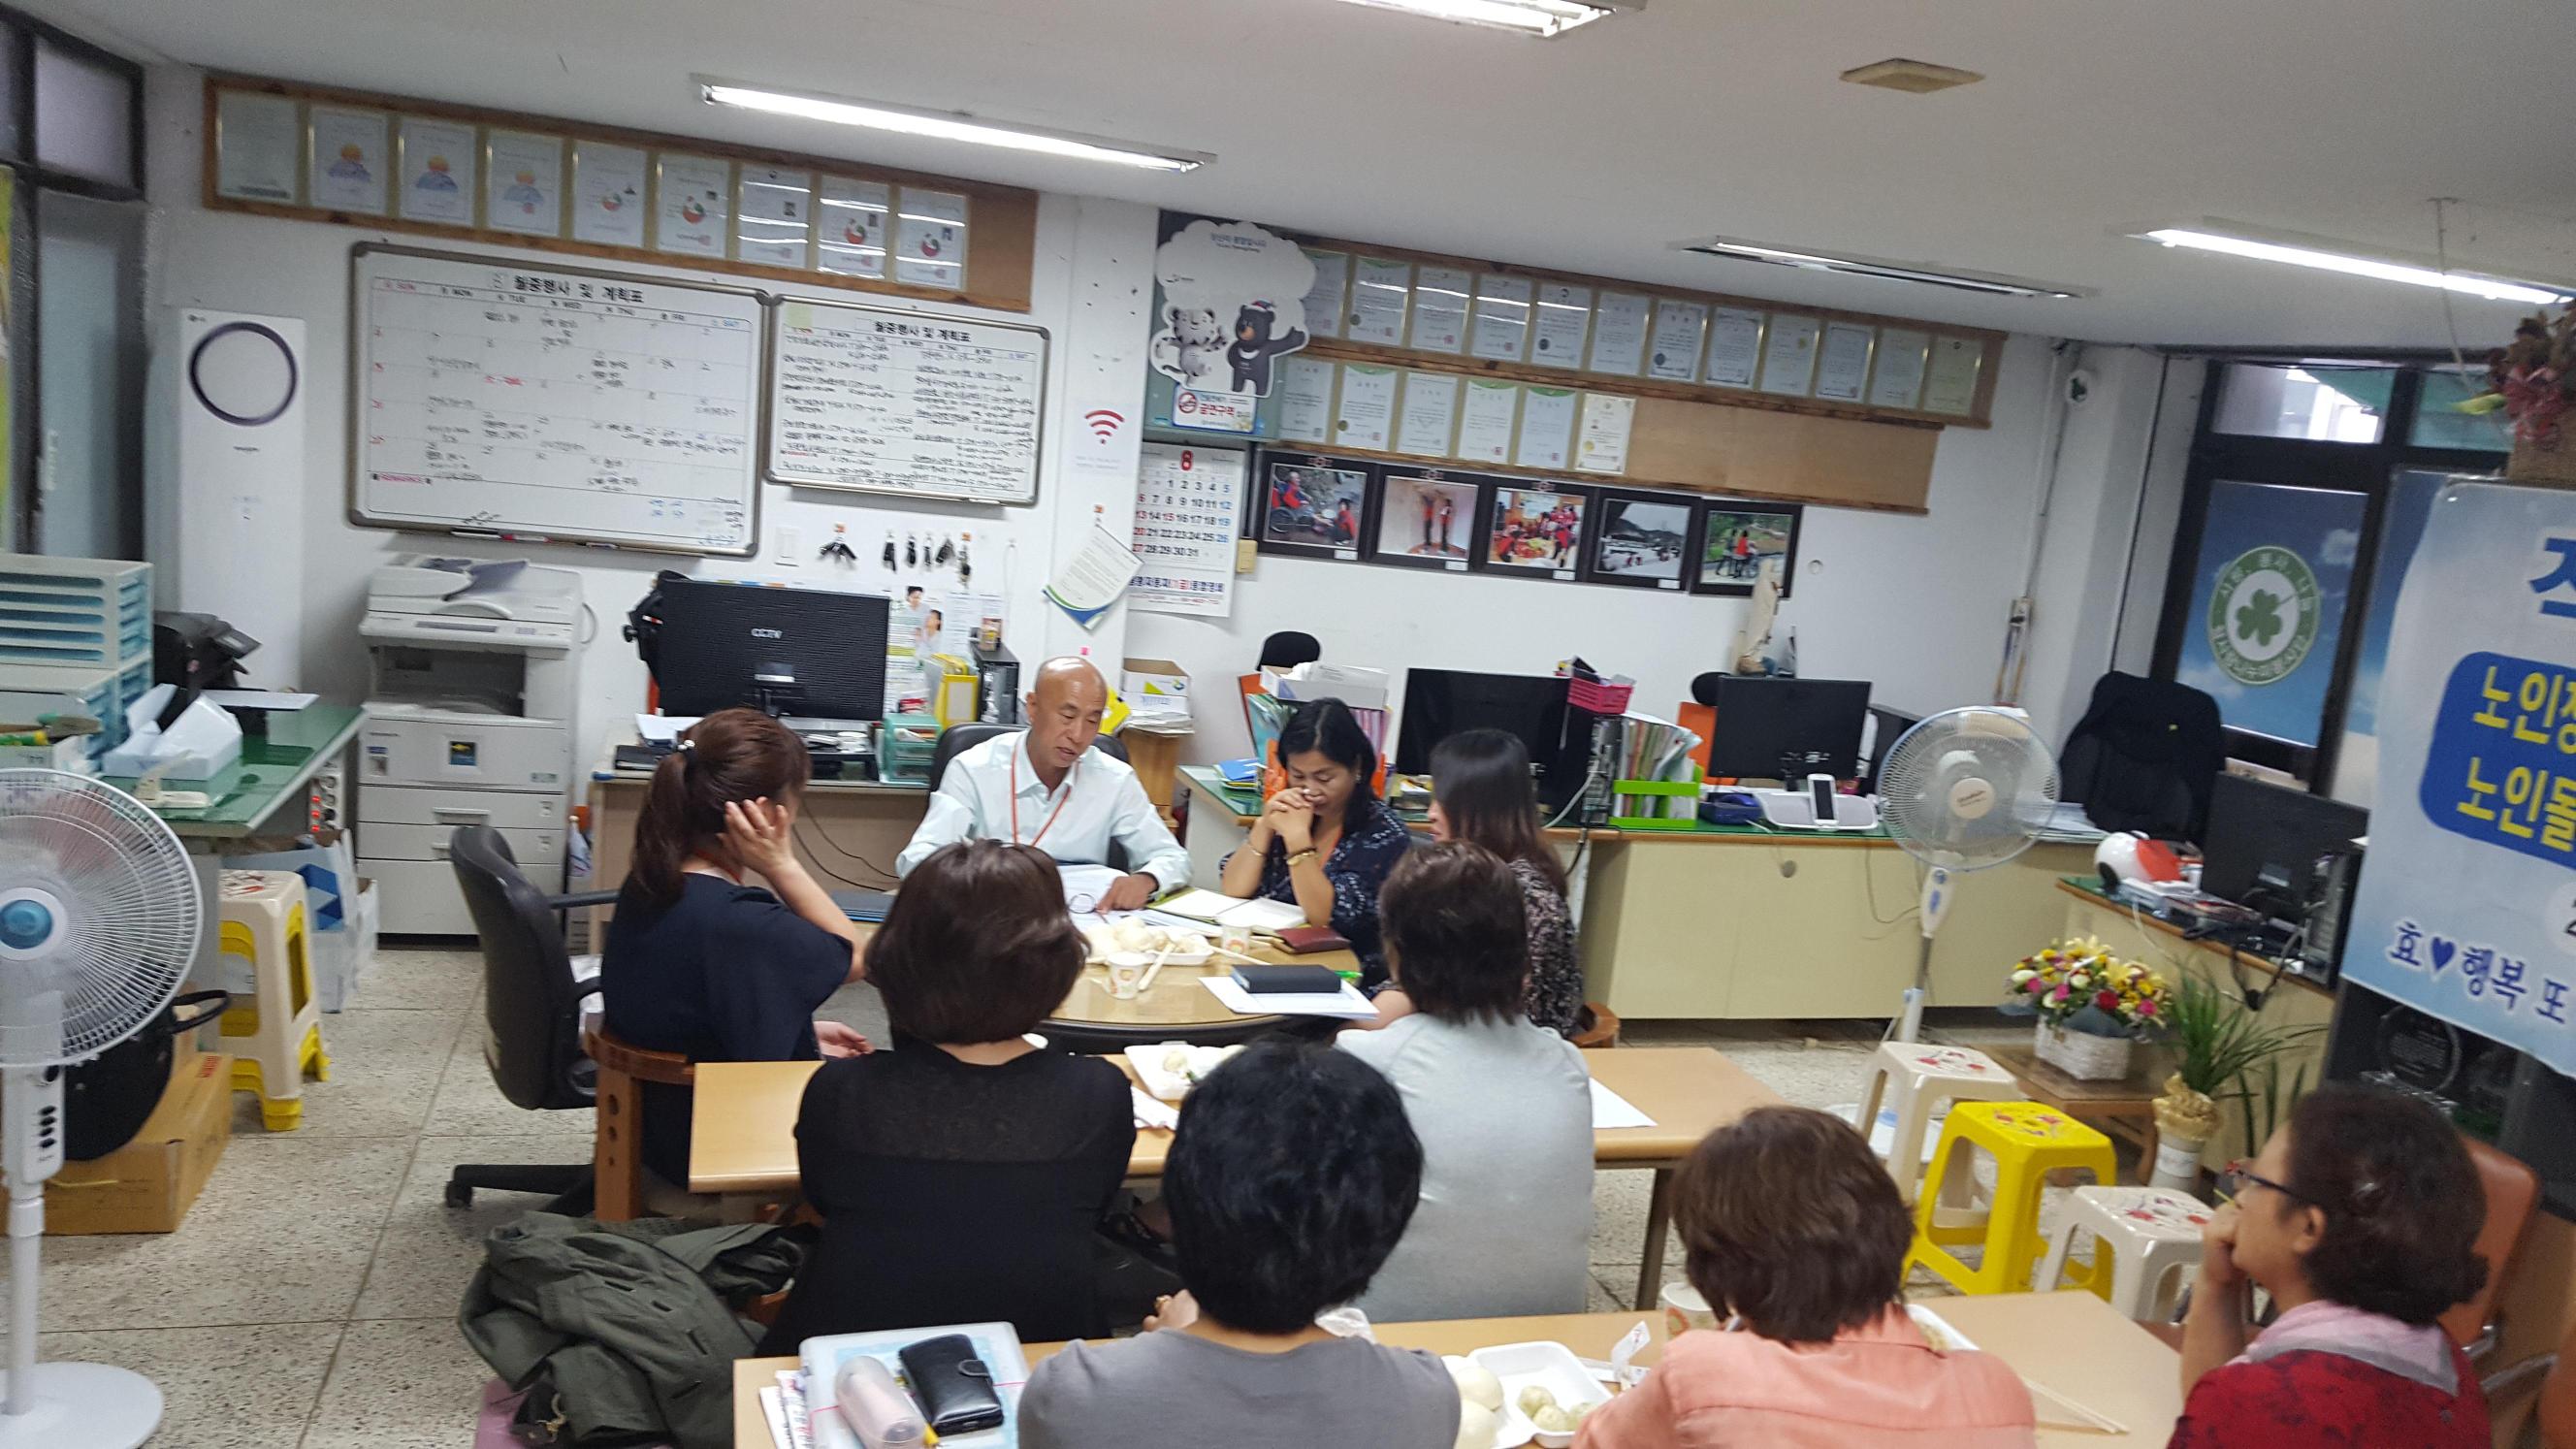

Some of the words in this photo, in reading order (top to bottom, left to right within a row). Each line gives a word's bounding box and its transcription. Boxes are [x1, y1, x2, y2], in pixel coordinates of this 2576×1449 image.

[1181, 450, 1193, 471] 8
[1180, 480, 1188, 489] 2
[1195, 482, 1202, 491] 3
[751, 628, 783, 639] CCTV
[2390, 921, 2423, 966] 효
[2463, 947, 2528, 1010] 행복
